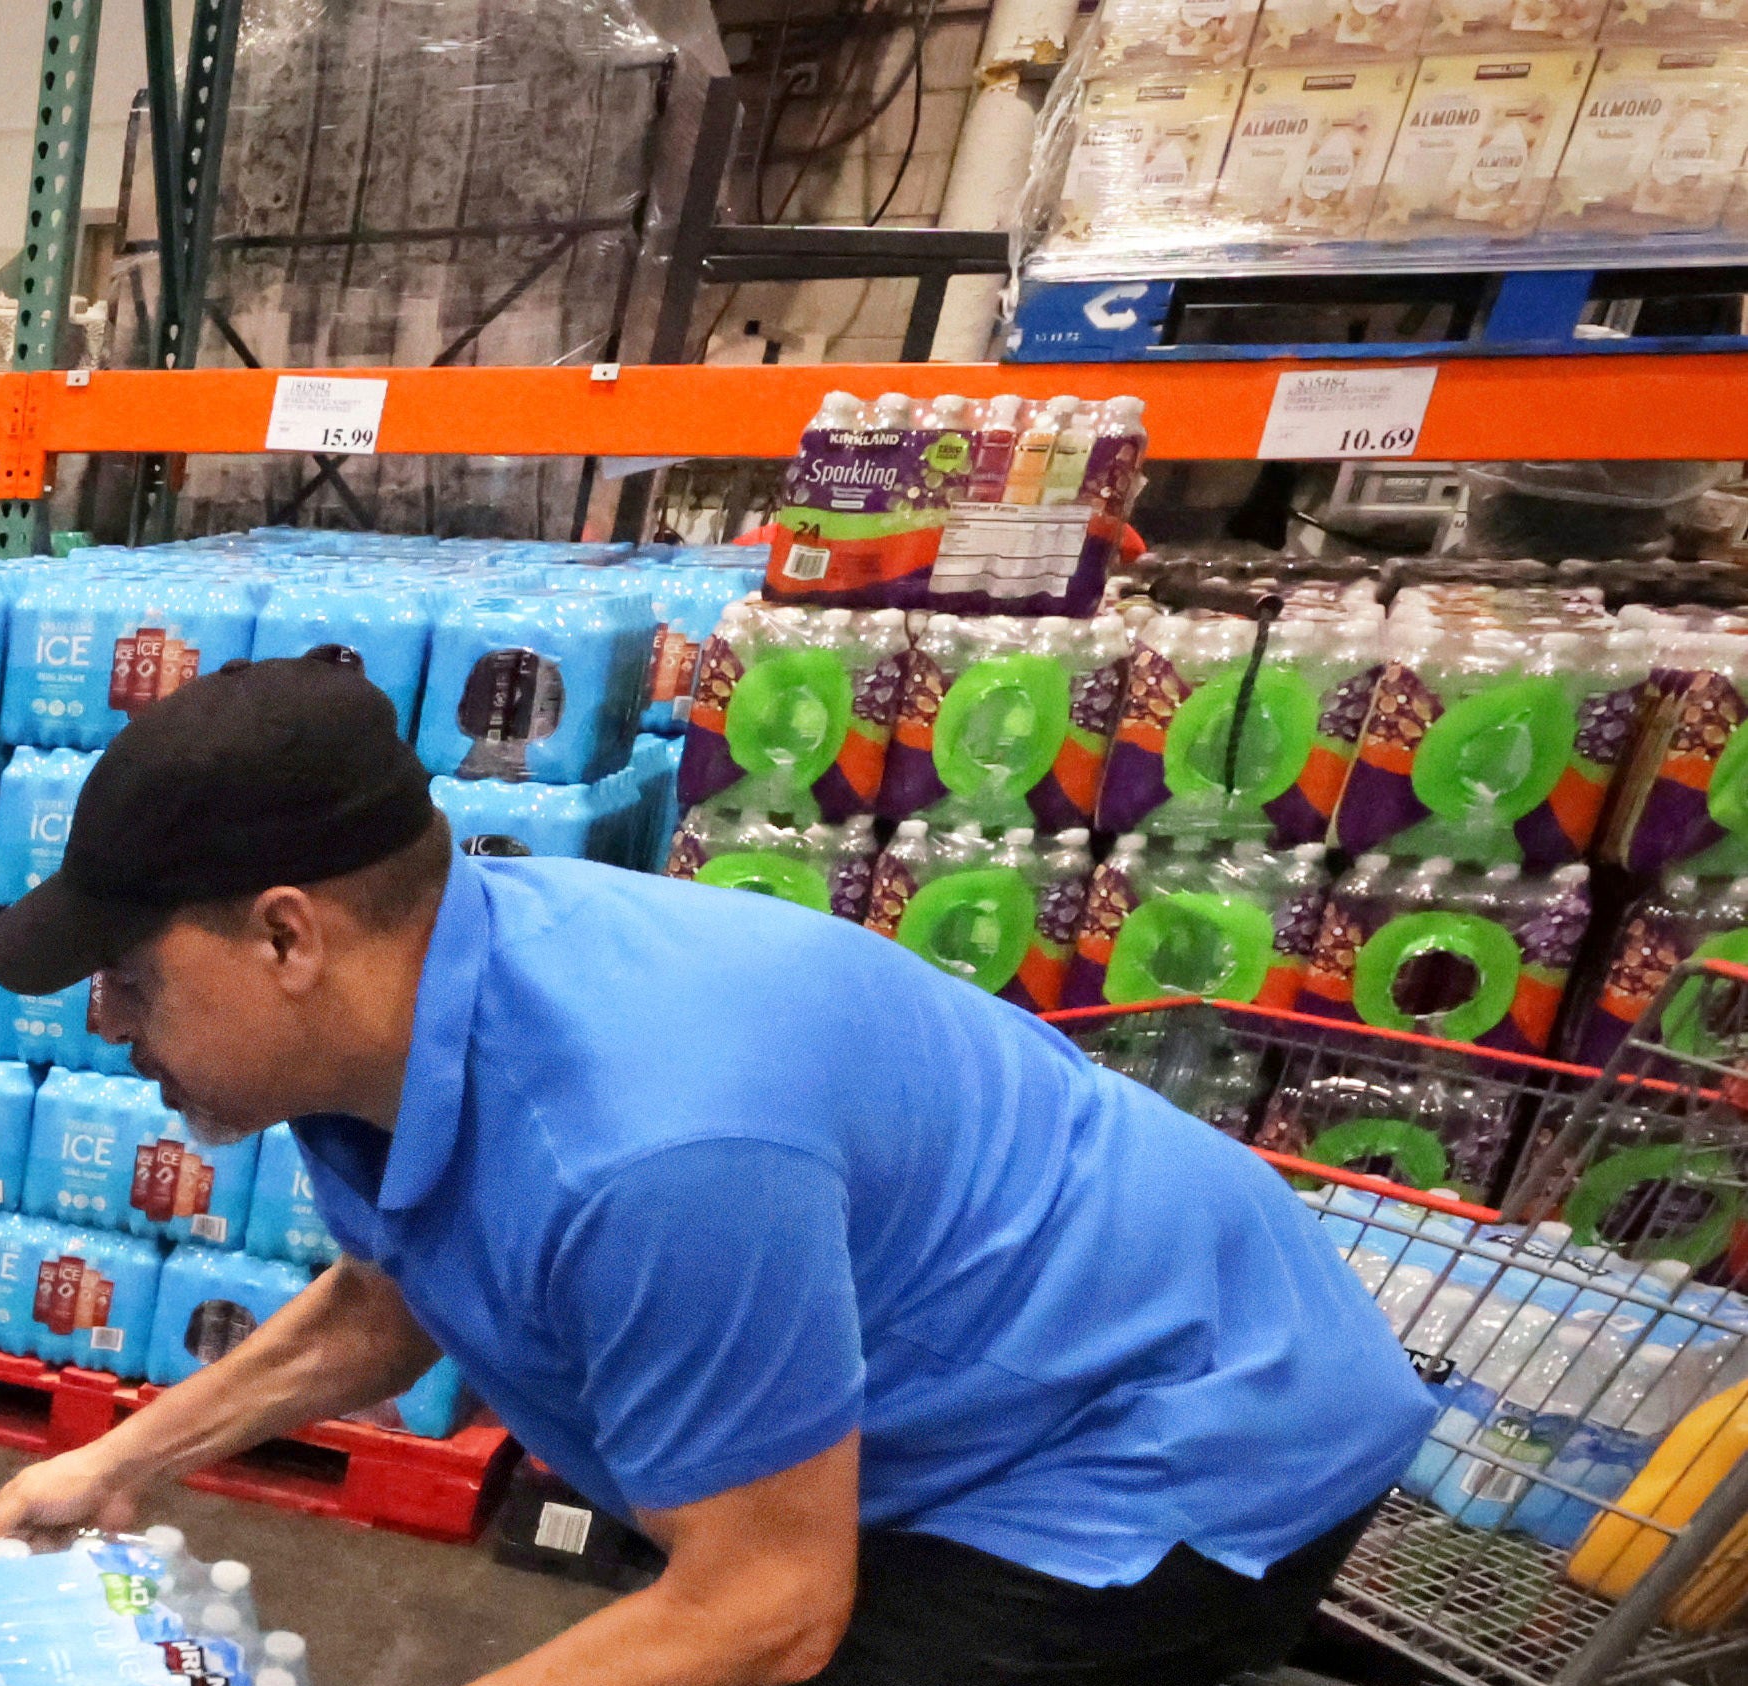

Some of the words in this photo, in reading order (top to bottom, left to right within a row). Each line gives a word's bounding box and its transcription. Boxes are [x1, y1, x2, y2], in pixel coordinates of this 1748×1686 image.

[1588, 98, 1662, 117] ALMOND
[1410, 108, 1480, 127] ALMOND
[1241, 118, 1308, 137] ALMOND
[1305, 166, 1349, 176] ALMOND
[1477, 155, 1523, 168] ALMOND
[321, 428, 373, 447] 15.99
[829, 431, 900, 446] KIRKLAND
[1339, 427, 1415, 451] 10.69
[809, 459, 898, 490] Sparkling
[797, 522, 821, 537] 24
[37, 636, 90, 666] ICE
[116, 648, 135, 660] ICE
[137, 641, 162, 656] ICE
[61, 1135, 114, 1166] ICE
[157, 1148, 181, 1164] ICE
[293, 1170, 314, 1199] IC
[59, 1266, 81, 1281] ICE
[131, 1575, 150, 1608] 40
